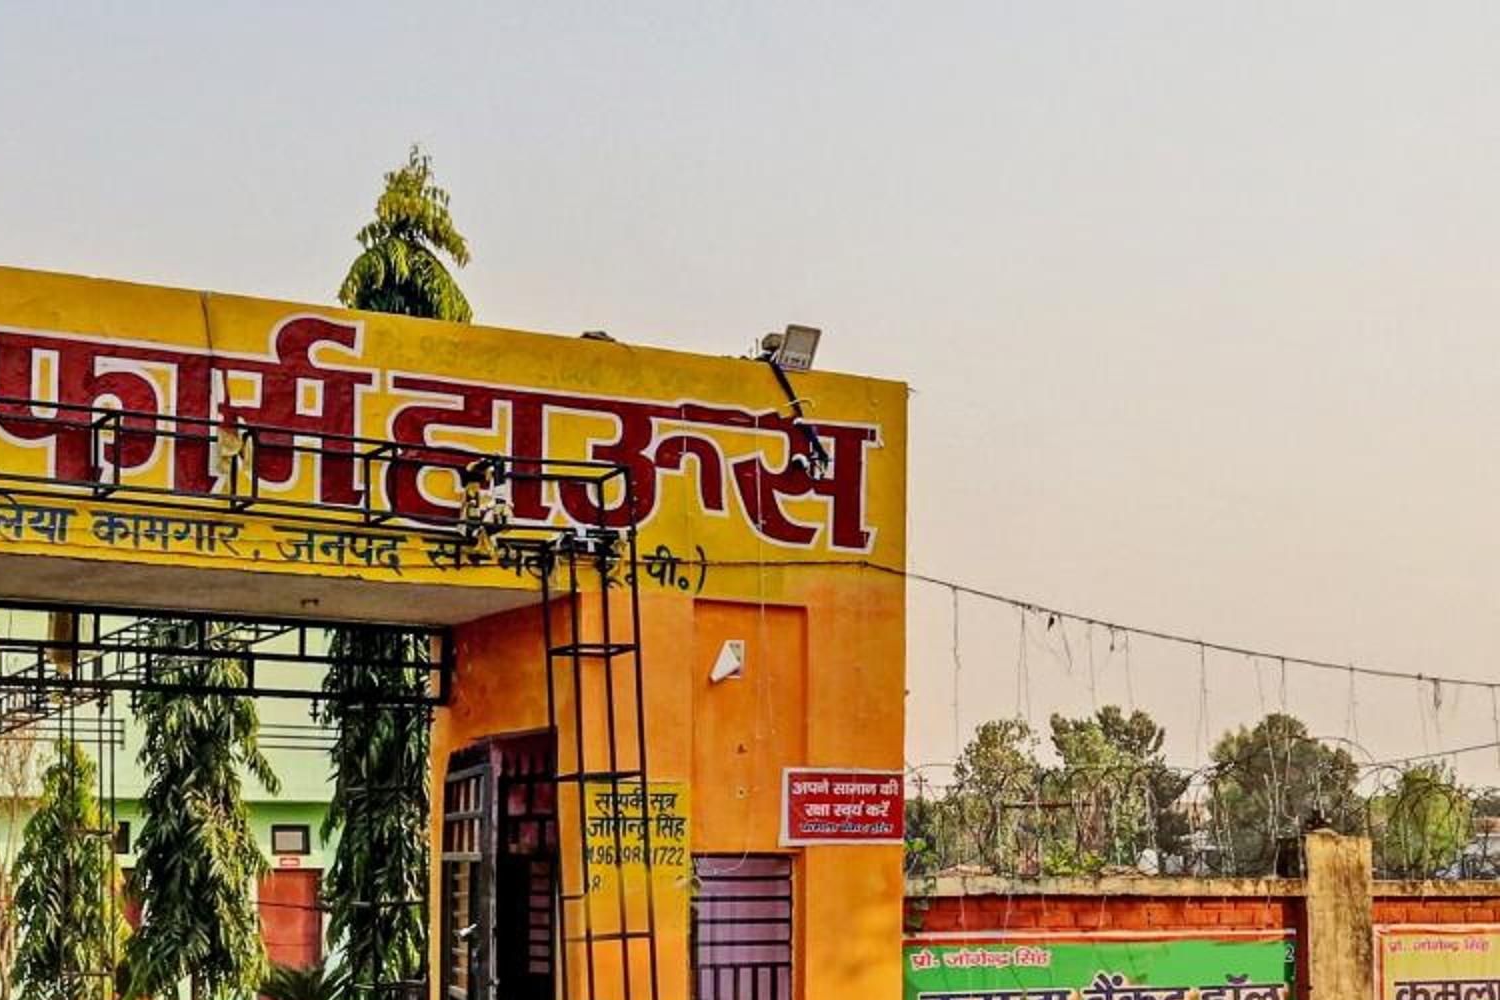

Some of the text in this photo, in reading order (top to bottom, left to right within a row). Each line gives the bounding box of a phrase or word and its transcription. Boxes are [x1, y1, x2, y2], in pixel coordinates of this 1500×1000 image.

[273, 525, 407, 576] जनपद
[792, 778, 899, 796] अपने सामान की
[804, 800, 891, 818] रक्षा स्वयं करें
[653, 813, 687, 842] सिंह
